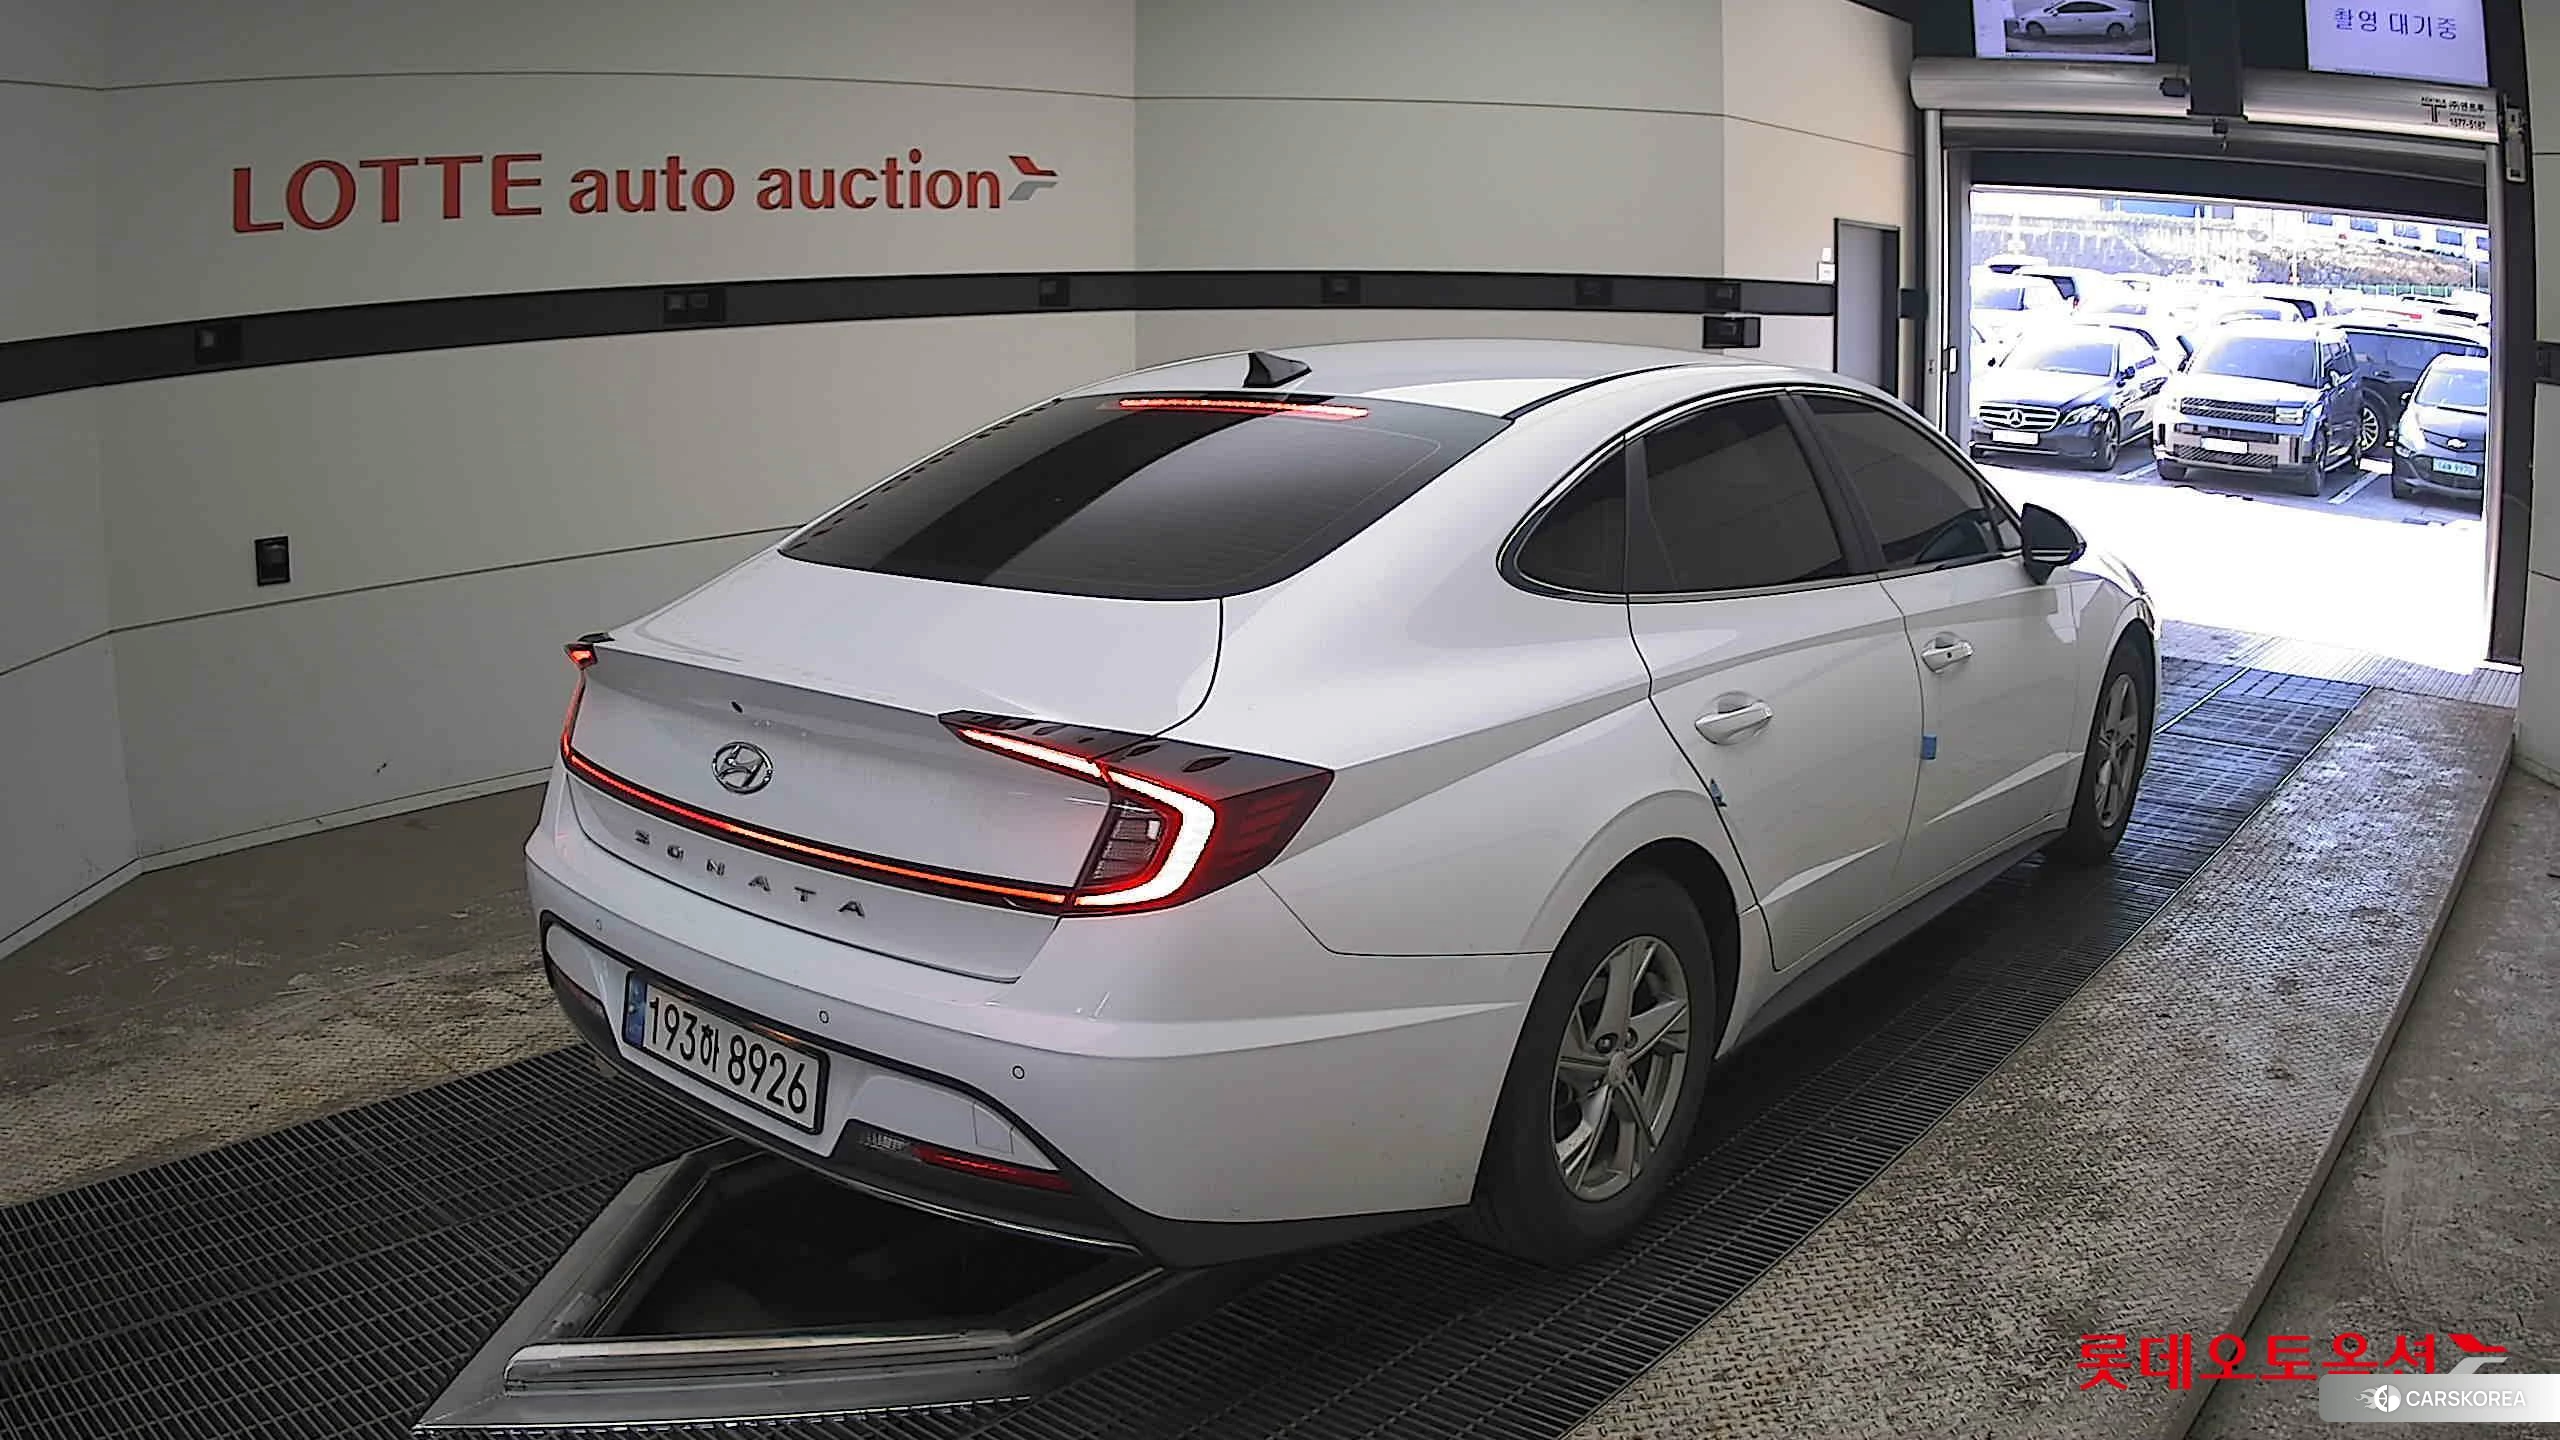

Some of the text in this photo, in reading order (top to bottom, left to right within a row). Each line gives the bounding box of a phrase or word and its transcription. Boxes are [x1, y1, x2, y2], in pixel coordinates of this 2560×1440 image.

[2335, 8, 2457, 40] 촬영 대기중
[233, 148, 1000, 233] LOTTE auto auction
[634, 828, 866, 918] SONATA
[649, 996, 808, 1114] 193하 8926
